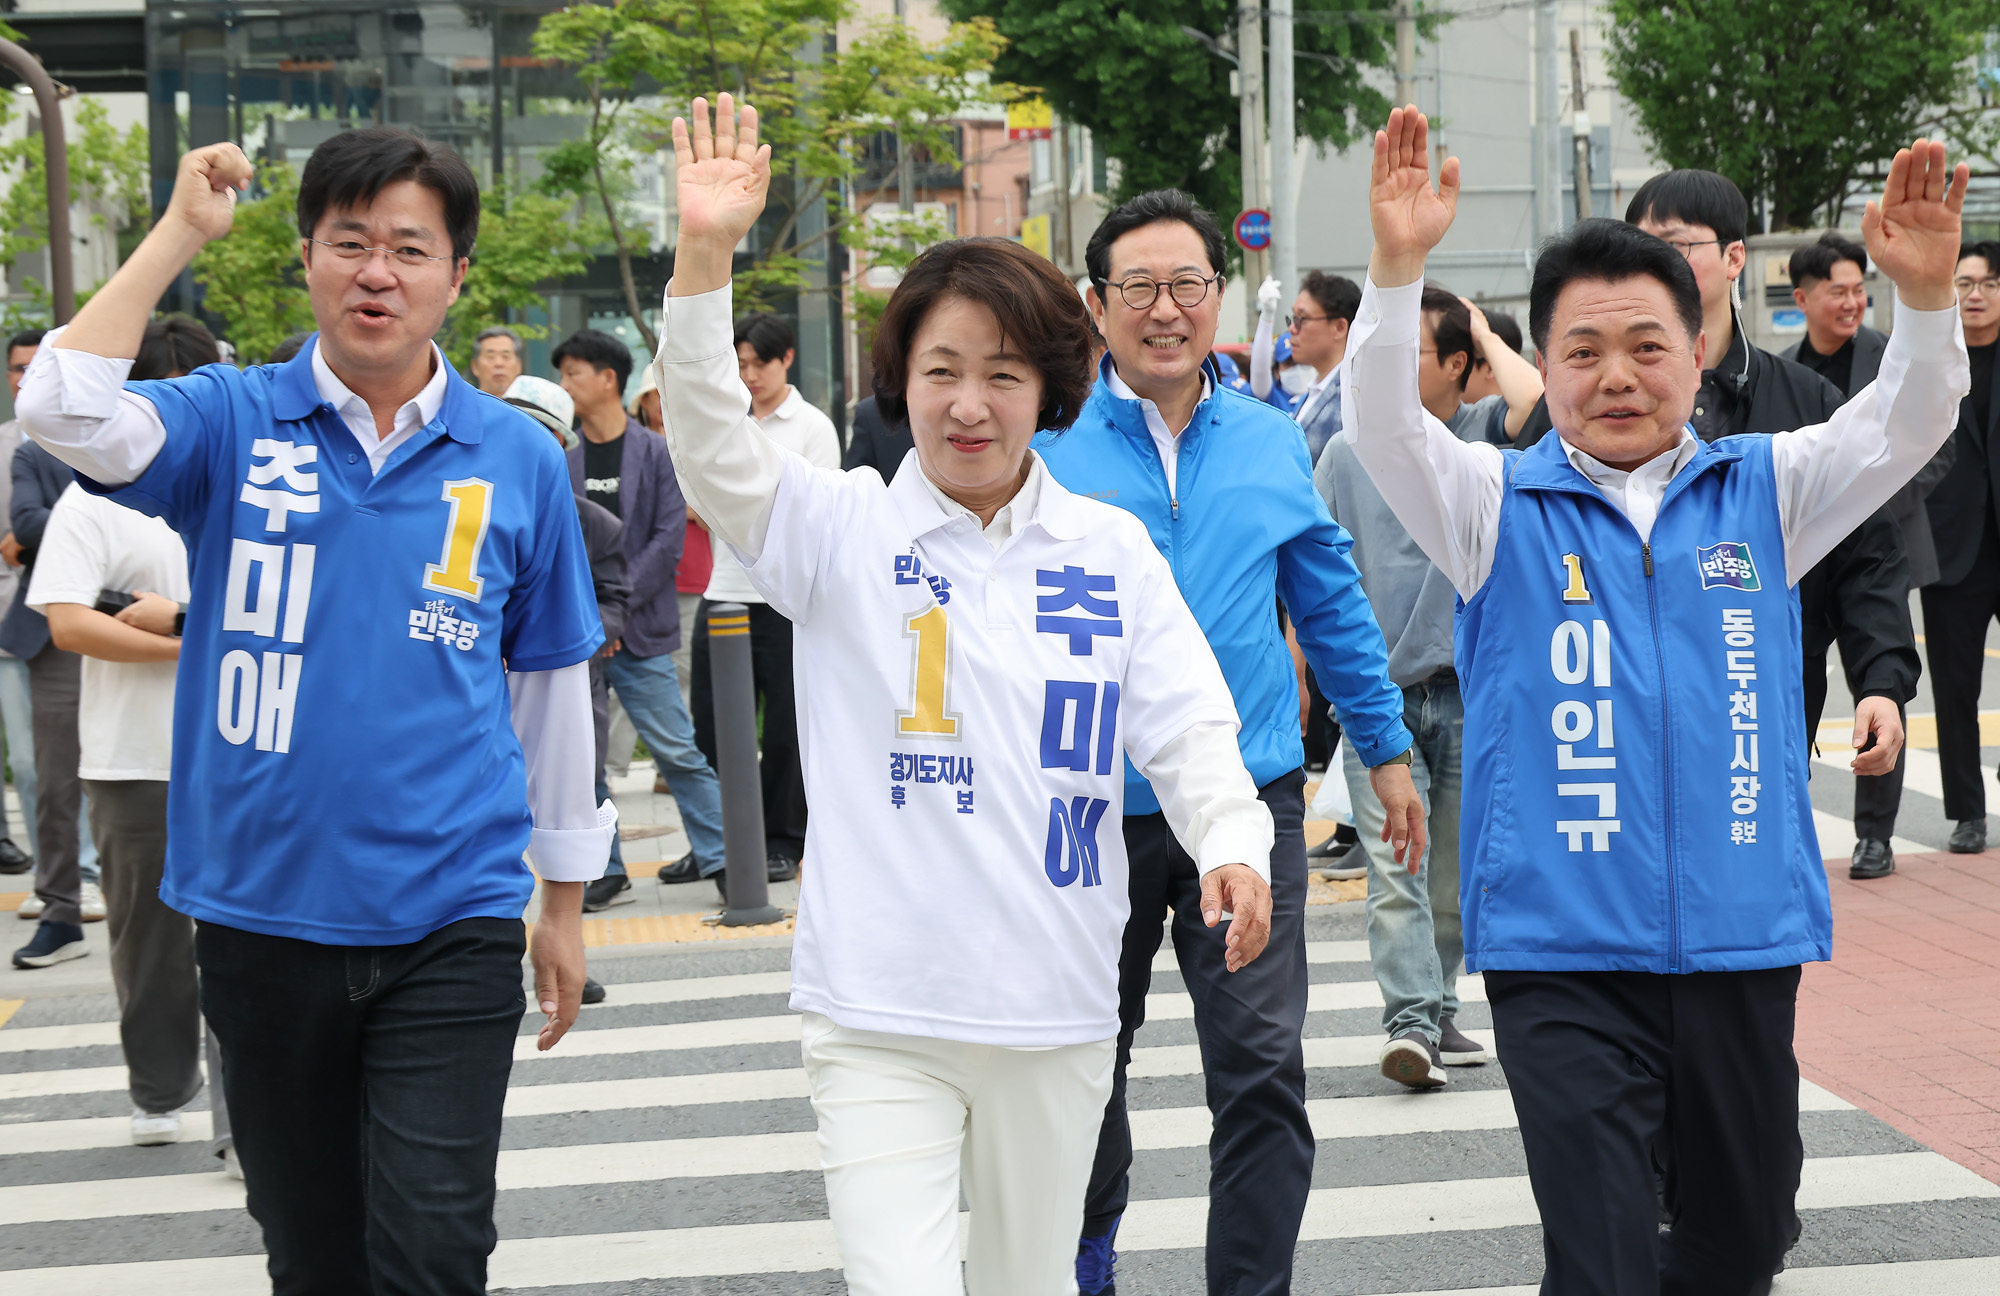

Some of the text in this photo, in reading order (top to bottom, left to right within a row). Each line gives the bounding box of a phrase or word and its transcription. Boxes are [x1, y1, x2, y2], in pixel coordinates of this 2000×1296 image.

[422, 476, 494, 604] 1
[894, 555, 952, 605] 민당
[1562, 551, 1594, 605] 1
[1702, 558, 1752, 579] 민주당
[217, 438, 321, 754] 추미애
[408, 608, 480, 651] 민주당
[424, 599, 456, 617] 더불어
[895, 598, 963, 742] 1
[890, 752, 974, 786] 경기도지사
[1035, 565, 1123, 888] 추미애
[1550, 619, 1621, 852] 이인규
[1721, 608, 1762, 845] 동두천시장 후보
